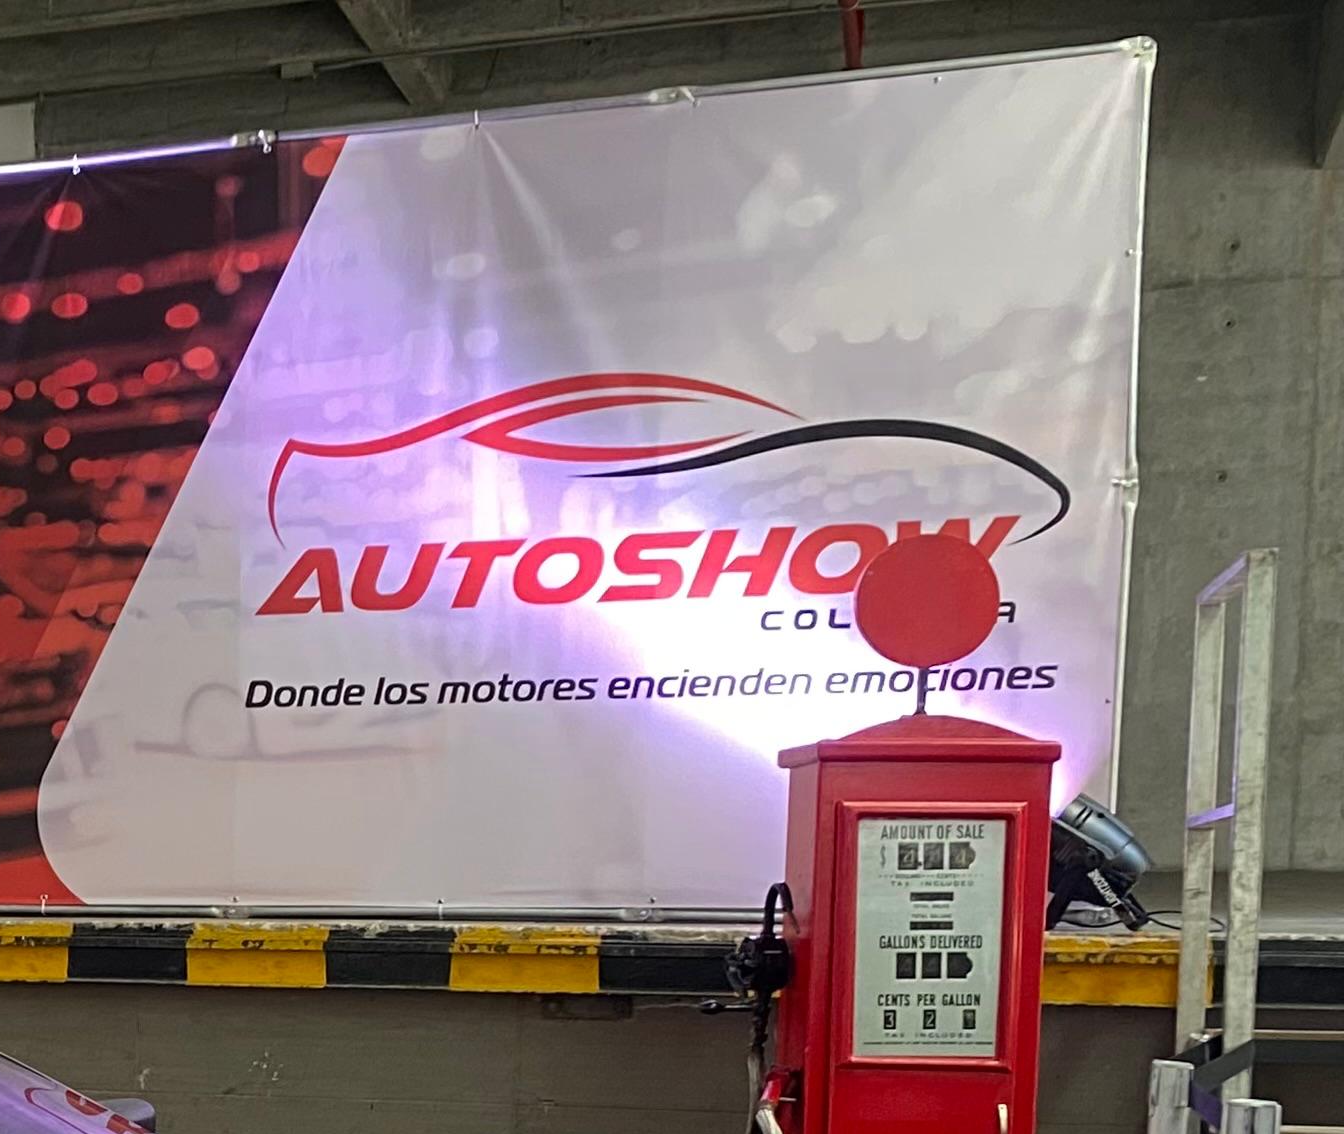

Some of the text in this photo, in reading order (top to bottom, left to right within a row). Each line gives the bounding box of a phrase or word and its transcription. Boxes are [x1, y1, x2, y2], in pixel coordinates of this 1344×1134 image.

[245, 663, 1059, 708] Donde los motores encienden emociones
[881, 823, 985, 840] AMOUNT OF SALE
[879, 935, 983, 949] GALLONS DELIVERED
[877, 994, 981, 1007] CENTS PER GALLON
